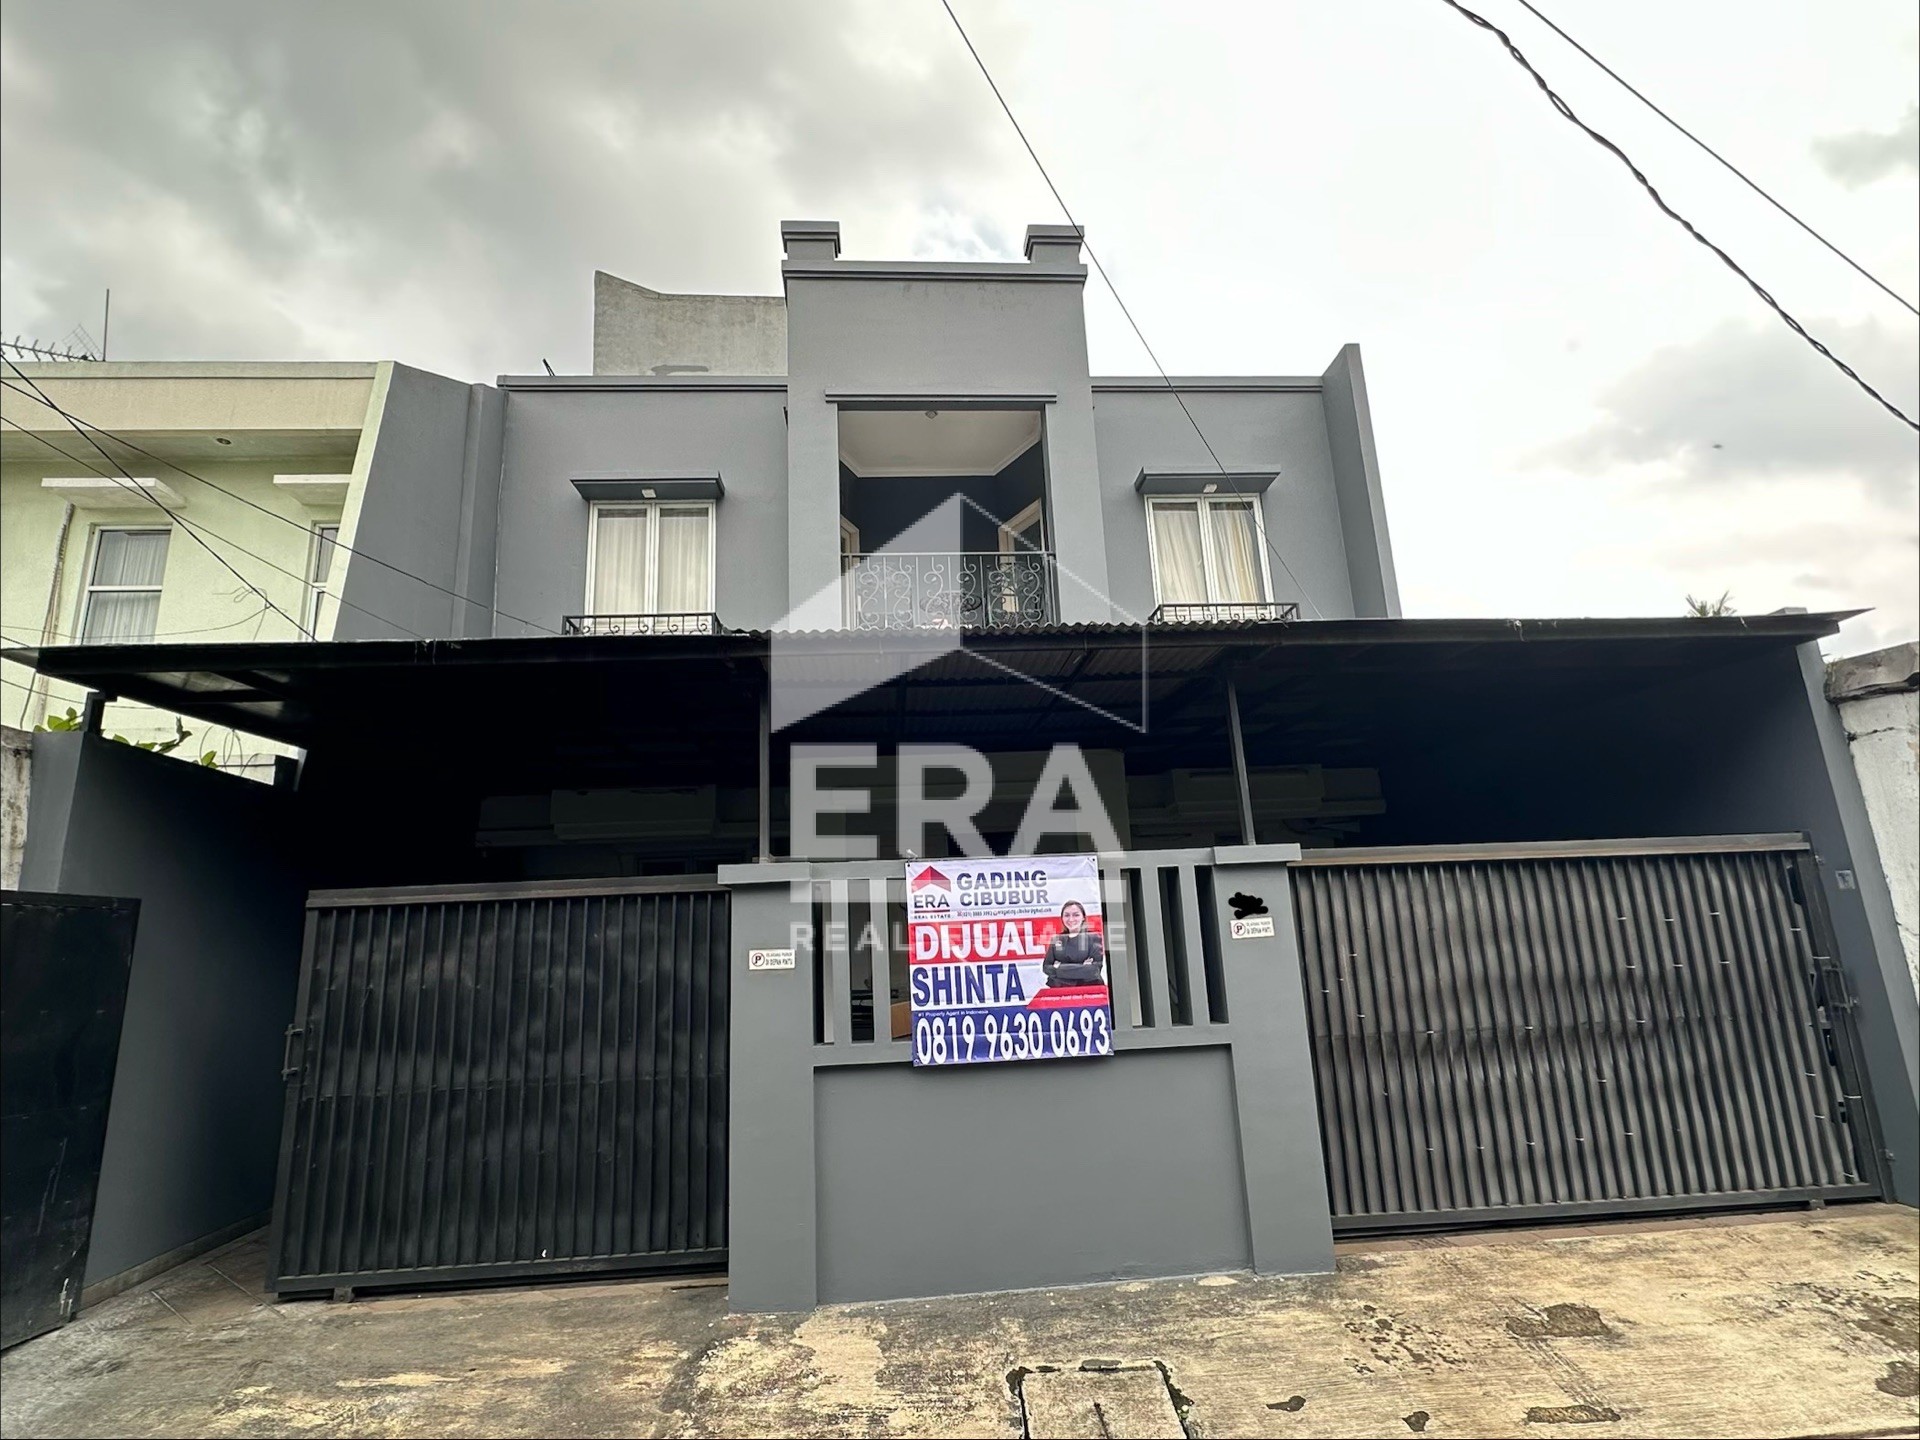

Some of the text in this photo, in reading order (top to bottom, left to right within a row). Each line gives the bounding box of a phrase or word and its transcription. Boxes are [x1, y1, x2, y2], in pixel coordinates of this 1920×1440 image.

[957, 870, 1047, 891] GADING
[913, 894, 950, 908] ERA
[959, 889, 1049, 907] CIBUBUR
[914, 921, 1045, 961] DIJUAL
[912, 963, 1026, 1007] SHINTA
[916, 1008, 1110, 1065] 0819 9630 0693
